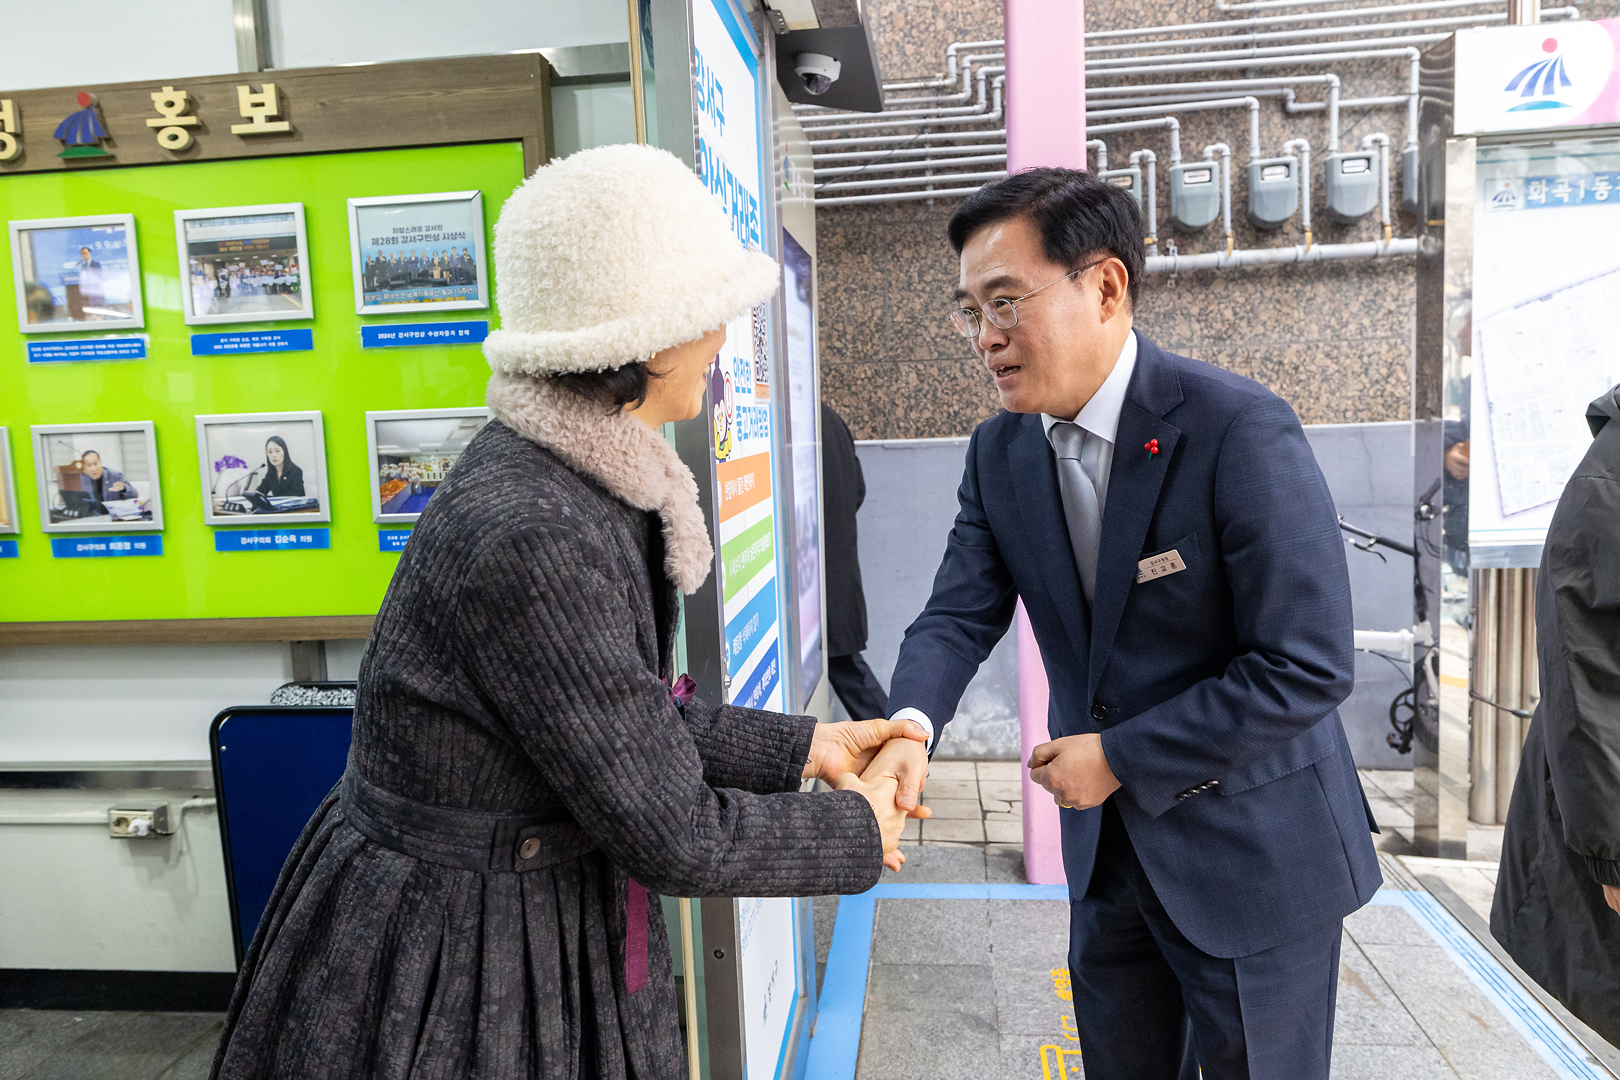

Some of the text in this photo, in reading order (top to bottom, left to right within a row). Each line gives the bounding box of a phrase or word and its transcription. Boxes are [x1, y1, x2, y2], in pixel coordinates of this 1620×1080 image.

[1527, 175, 1620, 205] 화곡1동
[371, 231, 466, 246] 제28회 강서구민상 시상식
[398, 330, 426, 338] 강서구민상
[427, 329, 456, 337] 수상자들과
